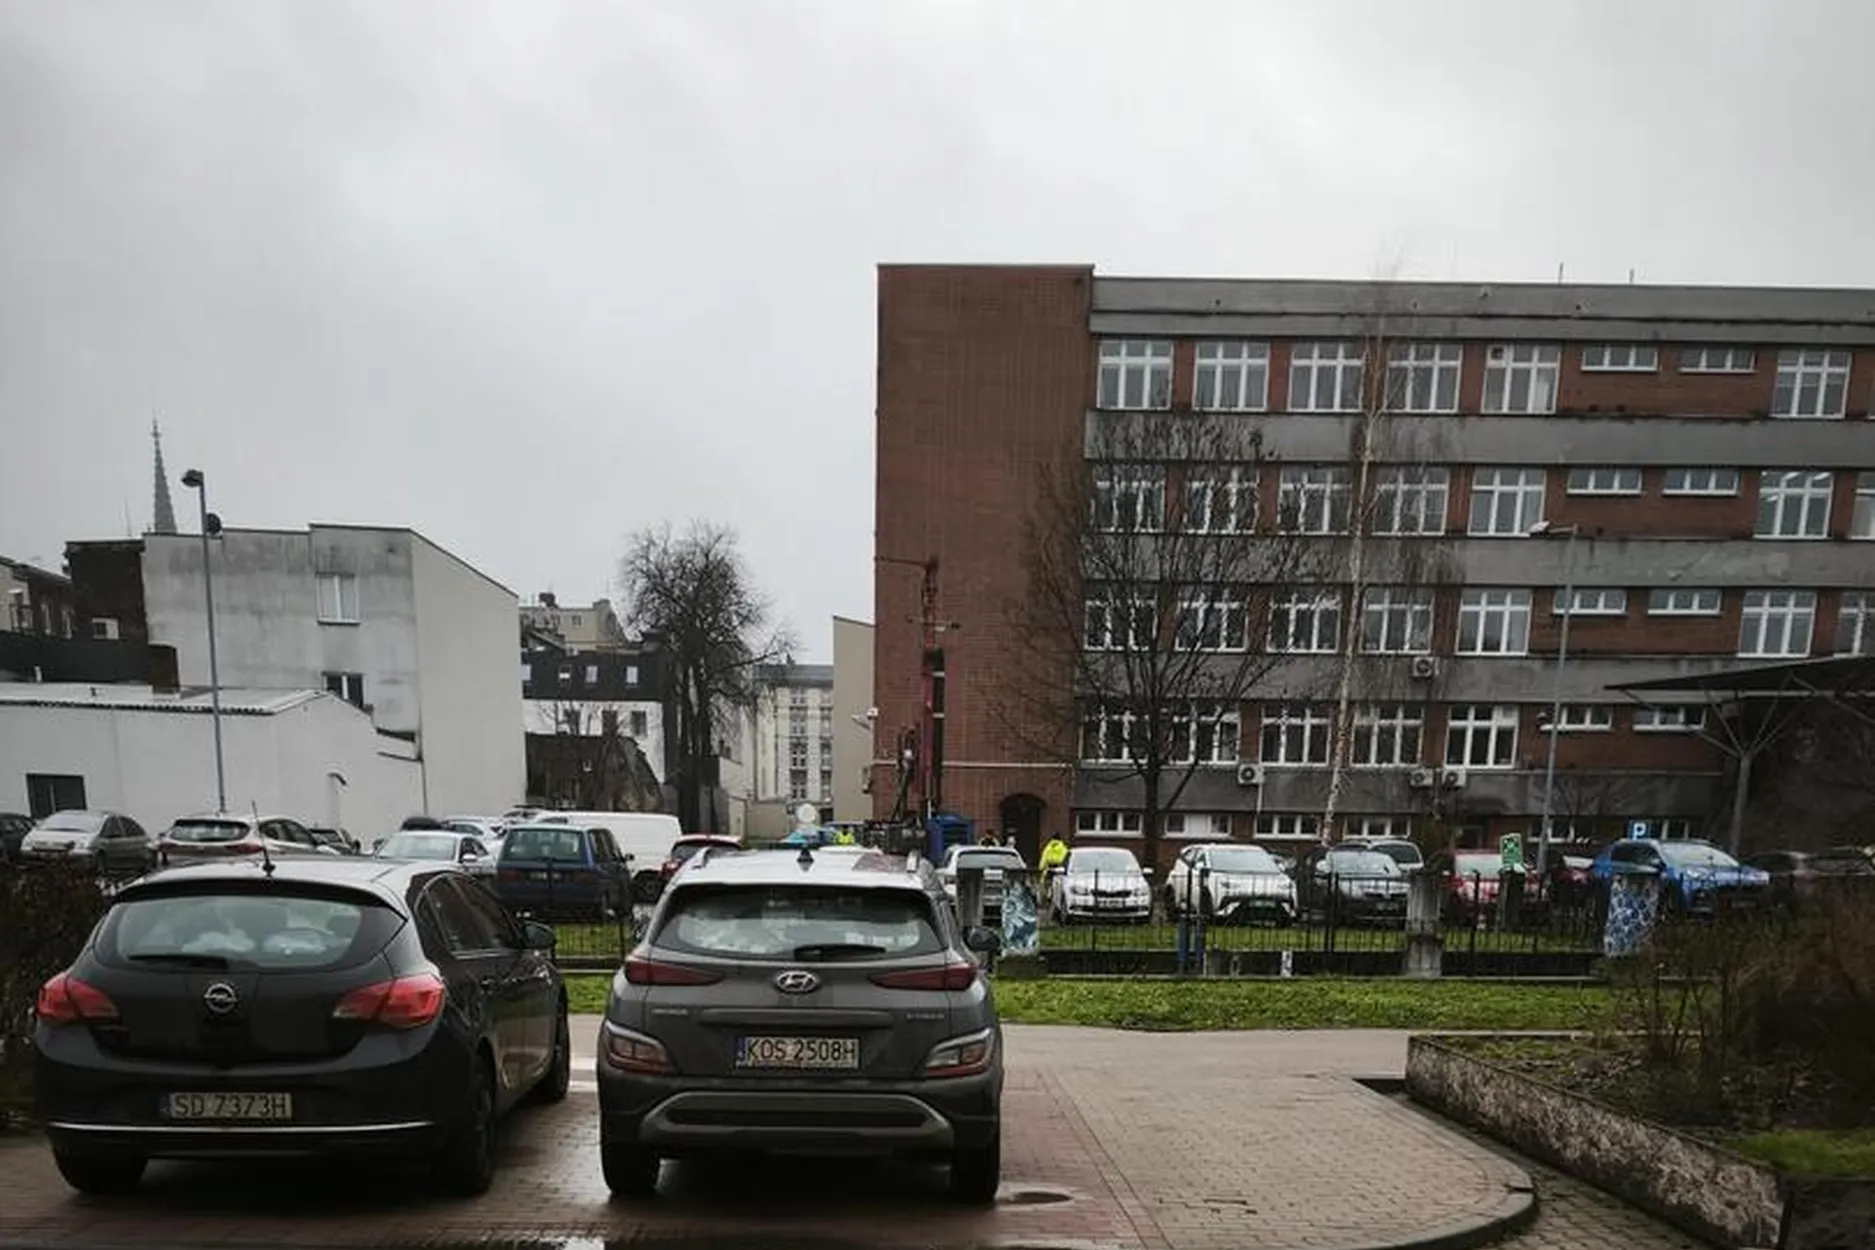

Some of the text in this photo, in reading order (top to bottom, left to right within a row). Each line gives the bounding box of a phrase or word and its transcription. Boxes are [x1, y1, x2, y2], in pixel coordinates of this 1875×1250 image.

[1633, 823, 1646, 840] P
[748, 1040, 855, 1060] KOS 2508H
[174, 1095, 286, 1117] SD 7373H
